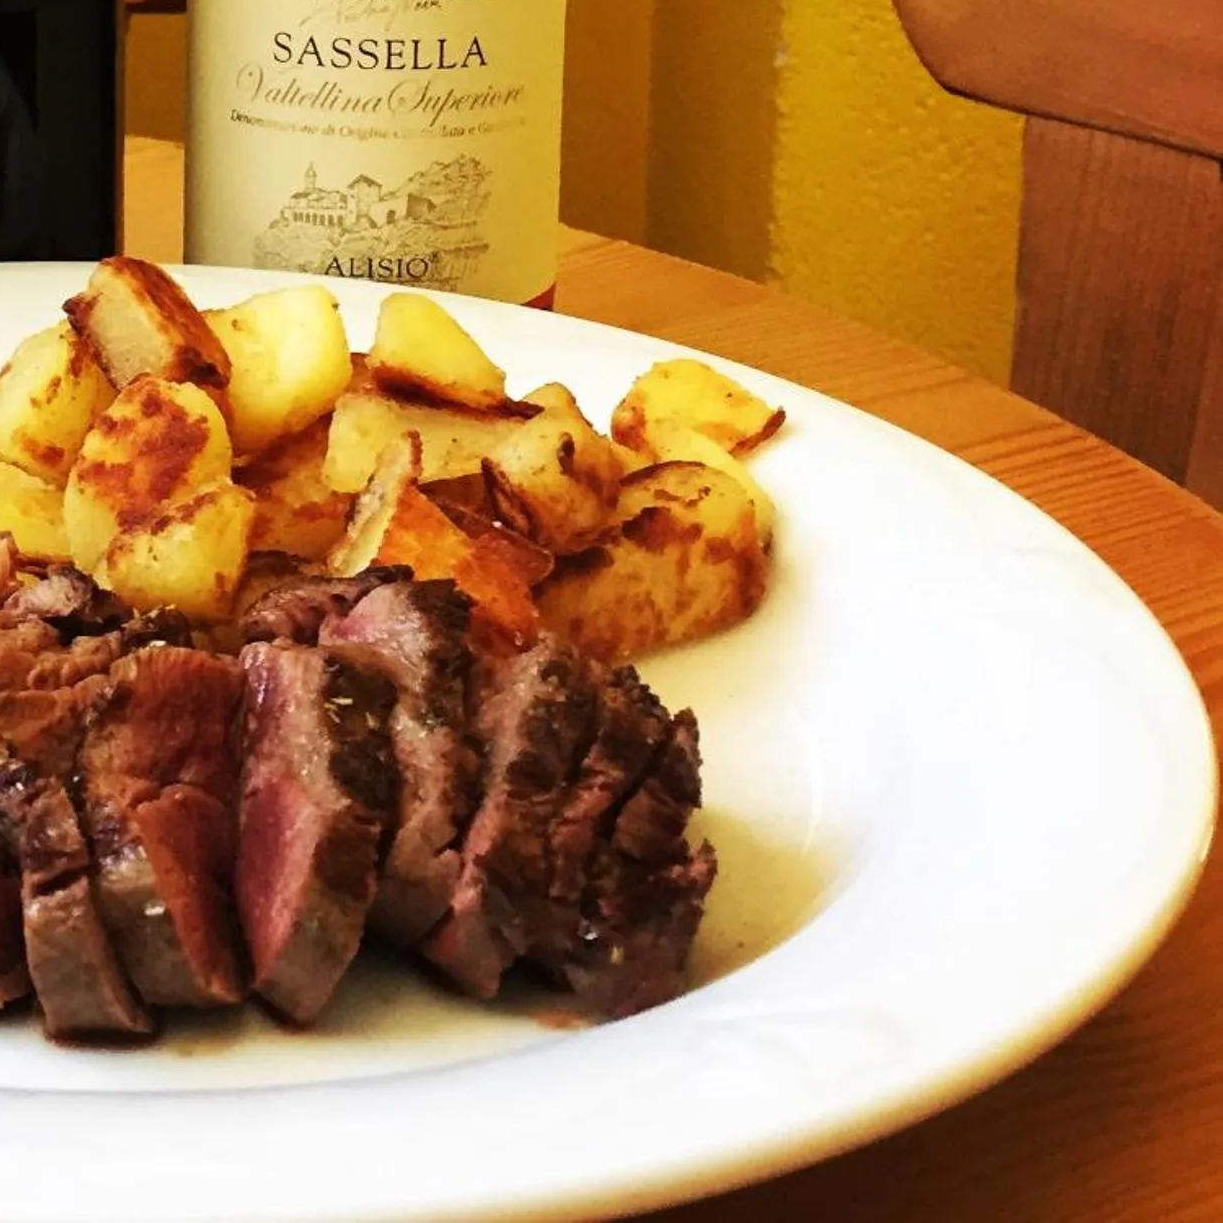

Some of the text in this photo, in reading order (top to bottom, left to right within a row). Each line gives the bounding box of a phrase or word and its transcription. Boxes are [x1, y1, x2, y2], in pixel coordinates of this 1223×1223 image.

[272, 31, 489, 71] SASSELLA
[235, 62, 526, 128] Valtellina Superiore
[323, 255, 430, 280] ALISIO
